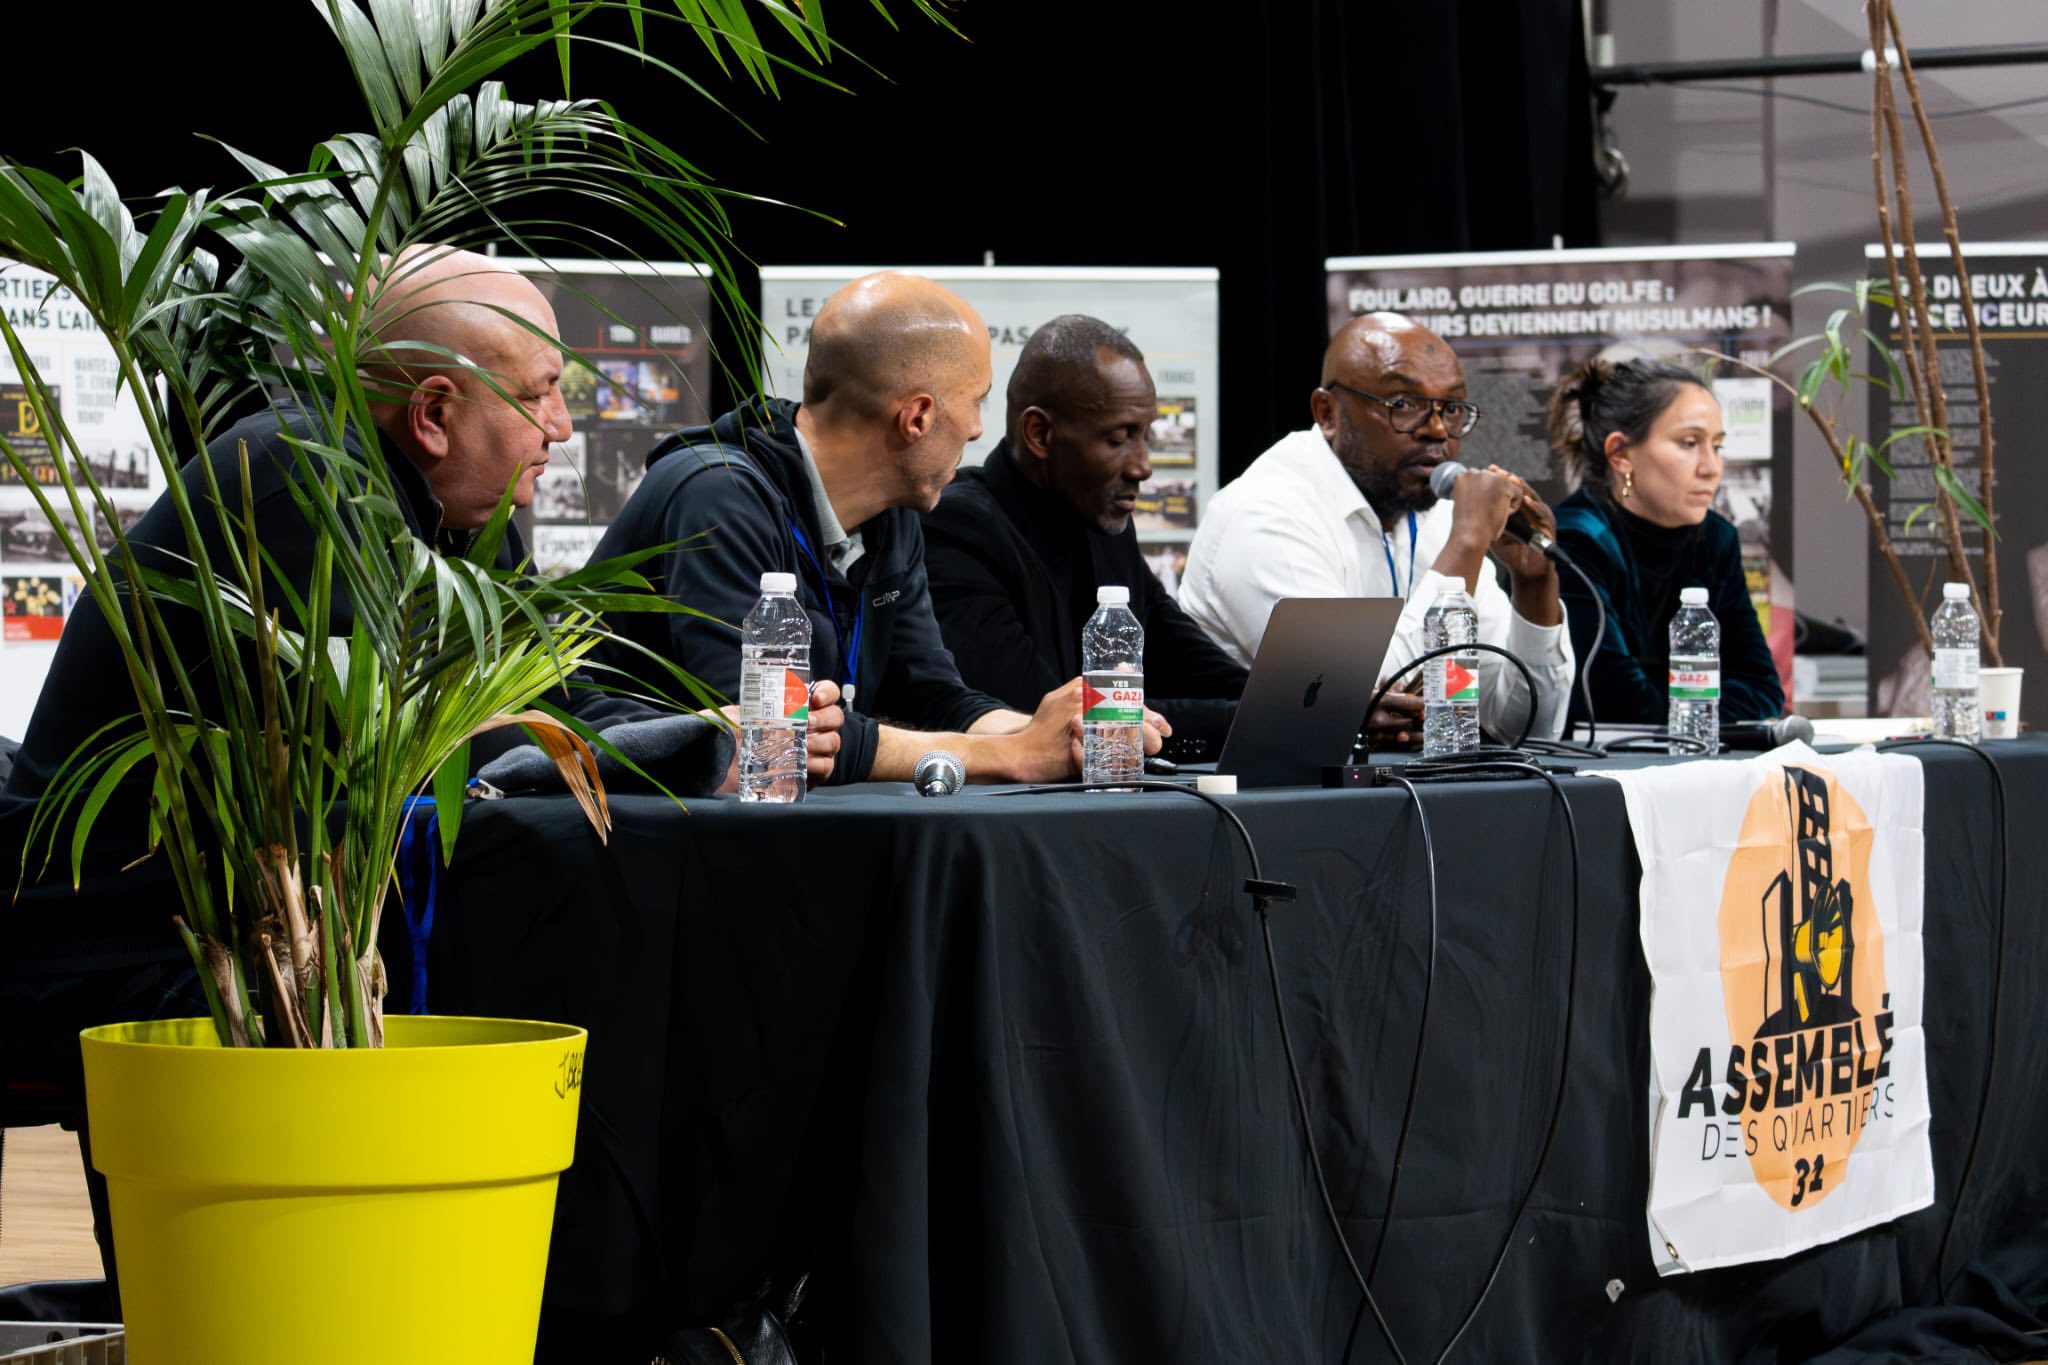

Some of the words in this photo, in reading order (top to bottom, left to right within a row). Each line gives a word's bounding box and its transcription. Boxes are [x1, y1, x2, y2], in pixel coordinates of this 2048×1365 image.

[786, 298, 813, 317] LE
[1349, 287, 1457, 311] FOULARD,
[1459, 283, 1550, 308] GUERRE
[1553, 282, 1586, 305] DU
[1587, 279, 1663, 304] GOLFE
[1469, 310, 1612, 337] DEVIENNENT
[1613, 305, 1759, 332] MUSULMANS
[1112, 680, 1129, 688] YES
[1701, 1119, 1759, 1161] DES
[1772, 1082, 1895, 1152] QUARTIERS
[1790, 1154, 1824, 1207] 31
